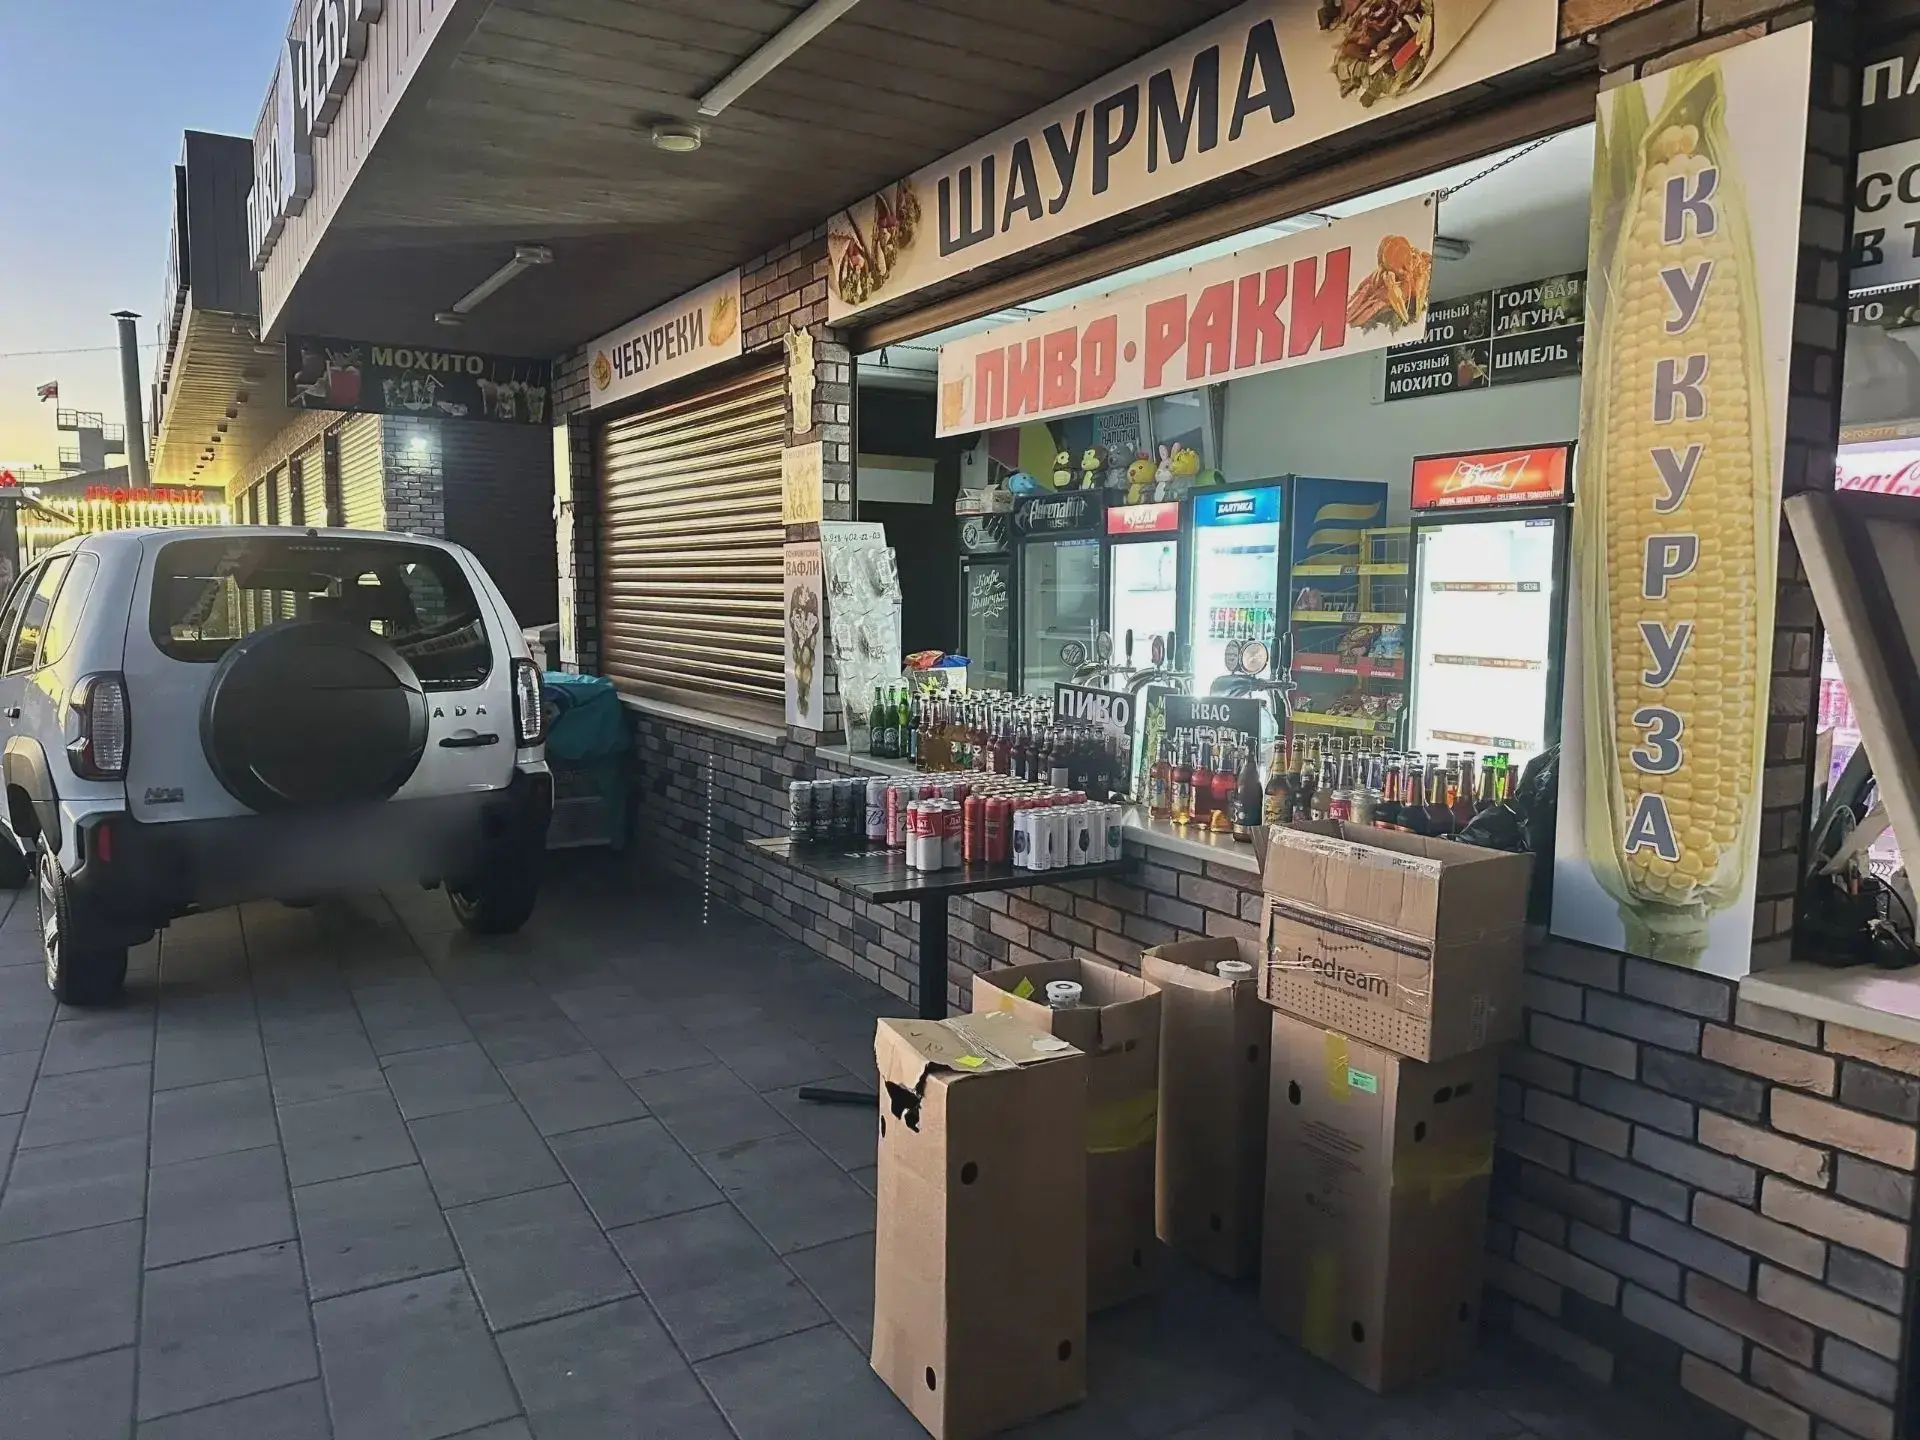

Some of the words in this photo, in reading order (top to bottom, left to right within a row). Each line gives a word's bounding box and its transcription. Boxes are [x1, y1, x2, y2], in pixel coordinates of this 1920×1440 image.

[299, 0, 363, 136] ЧЕБУ
[938, 18, 1295, 257] ШАУРМА
[1498, 279, 1579, 309] ГОЛУБАЯ
[1426, 303, 1470, 324] ИЧНЫЙ
[1497, 305, 1566, 331] ЛАГУНА
[612, 308, 704, 380] ЧЕБУРЕКИ
[975, 314, 1117, 425] ПИВО
[1143, 246, 1352, 390] РАКИ
[371, 347, 484, 375] МОХИТО
[1390, 354, 1449, 375] АРБУЗНЫЙ
[1495, 344, 1568, 369] ШМЕЛЬ
[1390, 371, 1453, 394] МОХИТО
[1460, 463, 1508, 486] Bud
[1625, 166, 1720, 862] КУКУРУЗА
[785, 560, 820, 577] ВАФЛИ
[433, 704, 487, 718] ADA
[1058, 688, 1130, 728] ПИВО
[1191, 703, 1231, 721] КВАС
[1297, 947, 1389, 997] icedream
